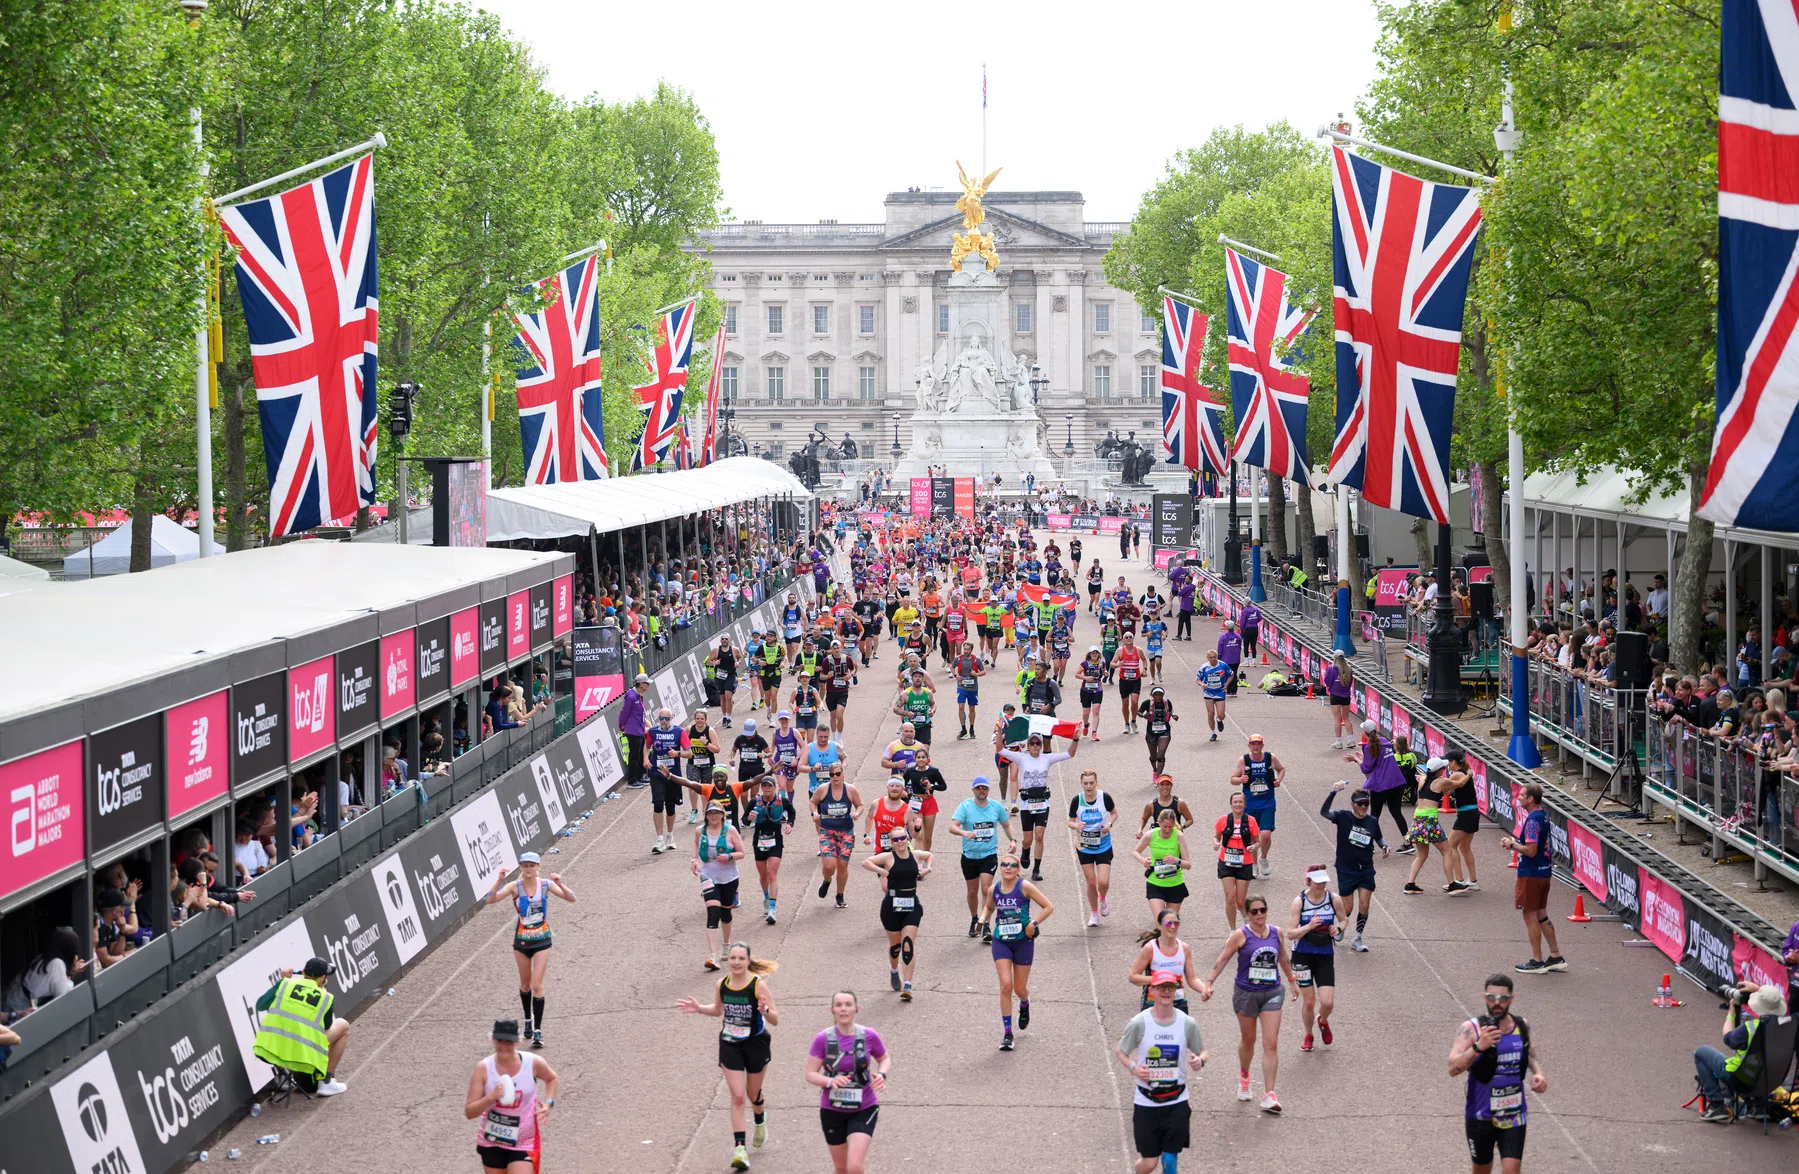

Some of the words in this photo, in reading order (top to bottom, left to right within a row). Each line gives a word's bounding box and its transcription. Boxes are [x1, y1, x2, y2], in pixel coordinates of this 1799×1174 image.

[934, 490, 947, 498] tcs
[1162, 511, 1177, 520] tcs
[1162, 535, 1177, 544] tcs
[1380, 580, 1394, 594] tcs
[421, 644, 431, 678] tcs
[295, 684, 310, 730] tcs
[342, 674, 354, 712] tcs
[238, 712, 254, 756] tcs
[256, 733, 270, 749] SERVICES
[121, 751, 136, 767] TATA
[38, 774, 59, 795] ABBOTT
[122, 763, 152, 786] CONSULTANCY
[556, 768, 576, 807] tcs
[38, 792, 58, 811] WORLD
[98, 764, 121, 816] tcs
[122, 786, 142, 807] SERVICES
[38, 804, 70, 829] MARATHON
[507, 803, 530, 847] tcs
[882, 814, 896, 822] WILL
[38, 825, 62, 847] MAJORS
[465, 834, 491, 880] tcs
[415, 869, 444, 921] tcs
[344, 914, 360, 935] TATA
[397, 915, 417, 944] TATA
[352, 923, 381, 956] CONSULTANCY
[324, 934, 360, 993] tcs
[359, 951, 379, 978] SERVICES
[1700, 945, 1734, 984] MARATHON
[170, 1036, 195, 1065] TATA
[181, 1044, 224, 1092] CONSULTANCY
[138, 1070, 189, 1144] tcs
[188, 1081, 219, 1120] SERVICES
